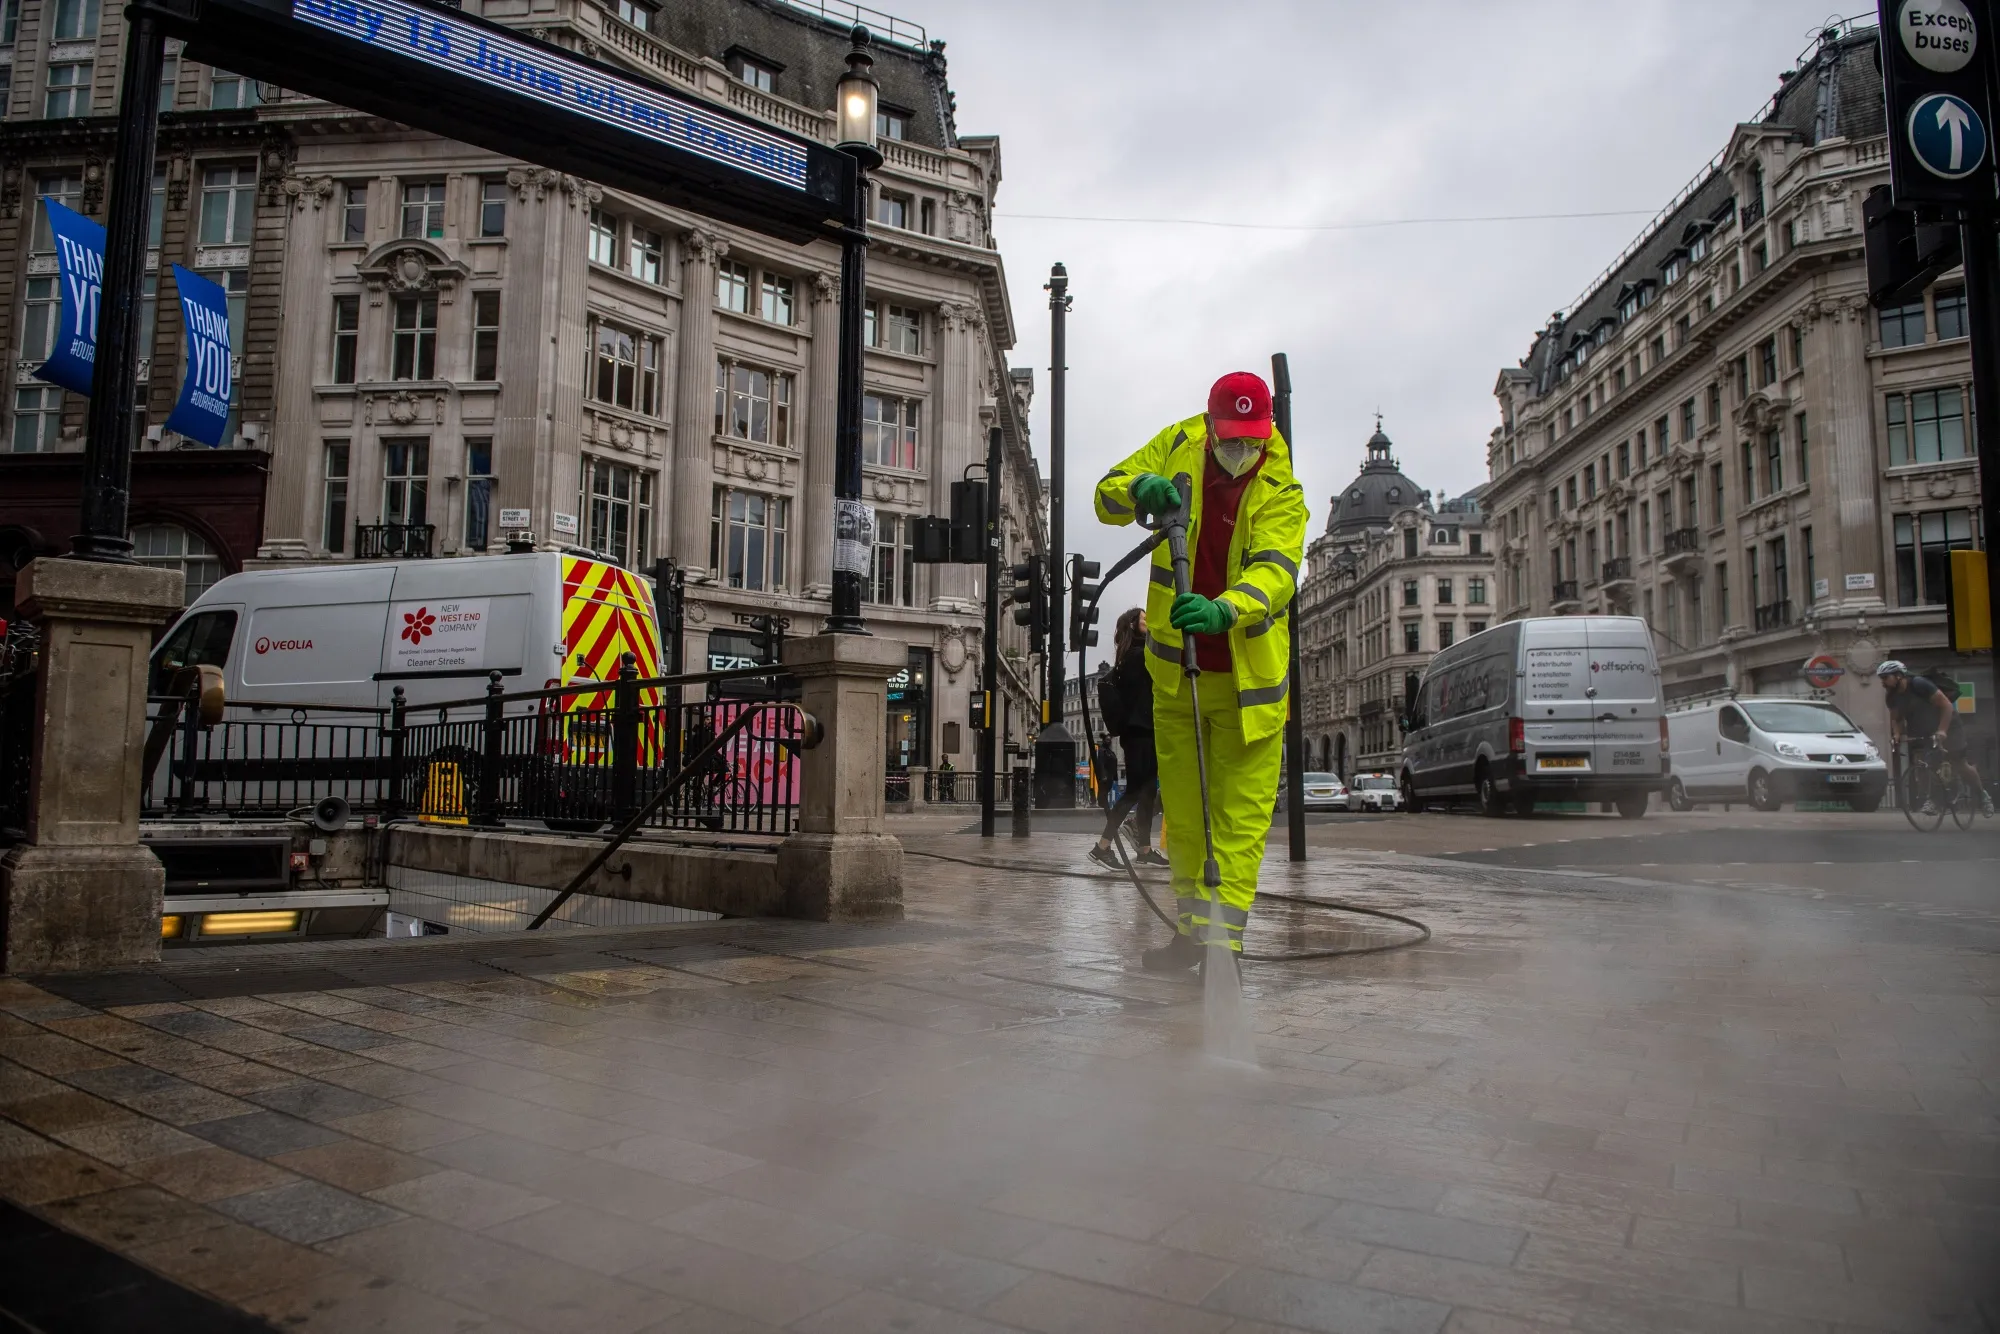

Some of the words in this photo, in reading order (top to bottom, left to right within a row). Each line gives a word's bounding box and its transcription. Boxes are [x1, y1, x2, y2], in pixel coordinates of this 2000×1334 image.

[1909, 11, 1973, 34] Except
[1915, 31, 1969, 53] buses
[404, 14, 451, 56] 15
[465, 37, 563, 95] June
[574, 81, 671, 131] when
[184, 296, 231, 349] THANK
[193, 332, 231, 401] YOU
[190, 389, 229, 419] #OURHEROES
[556, 514, 571, 522] OXFORD
[441, 605, 460, 613] NEW
[440, 614, 463, 622] WEST
[464, 613, 481, 621] END
[438, 623, 478, 633] COMPANY
[272, 640, 313, 650] VEOLIA
[407, 658, 437, 667] Cleaner
[437, 657, 466, 665] Streets
[1602, 661, 1645, 672] offspring
